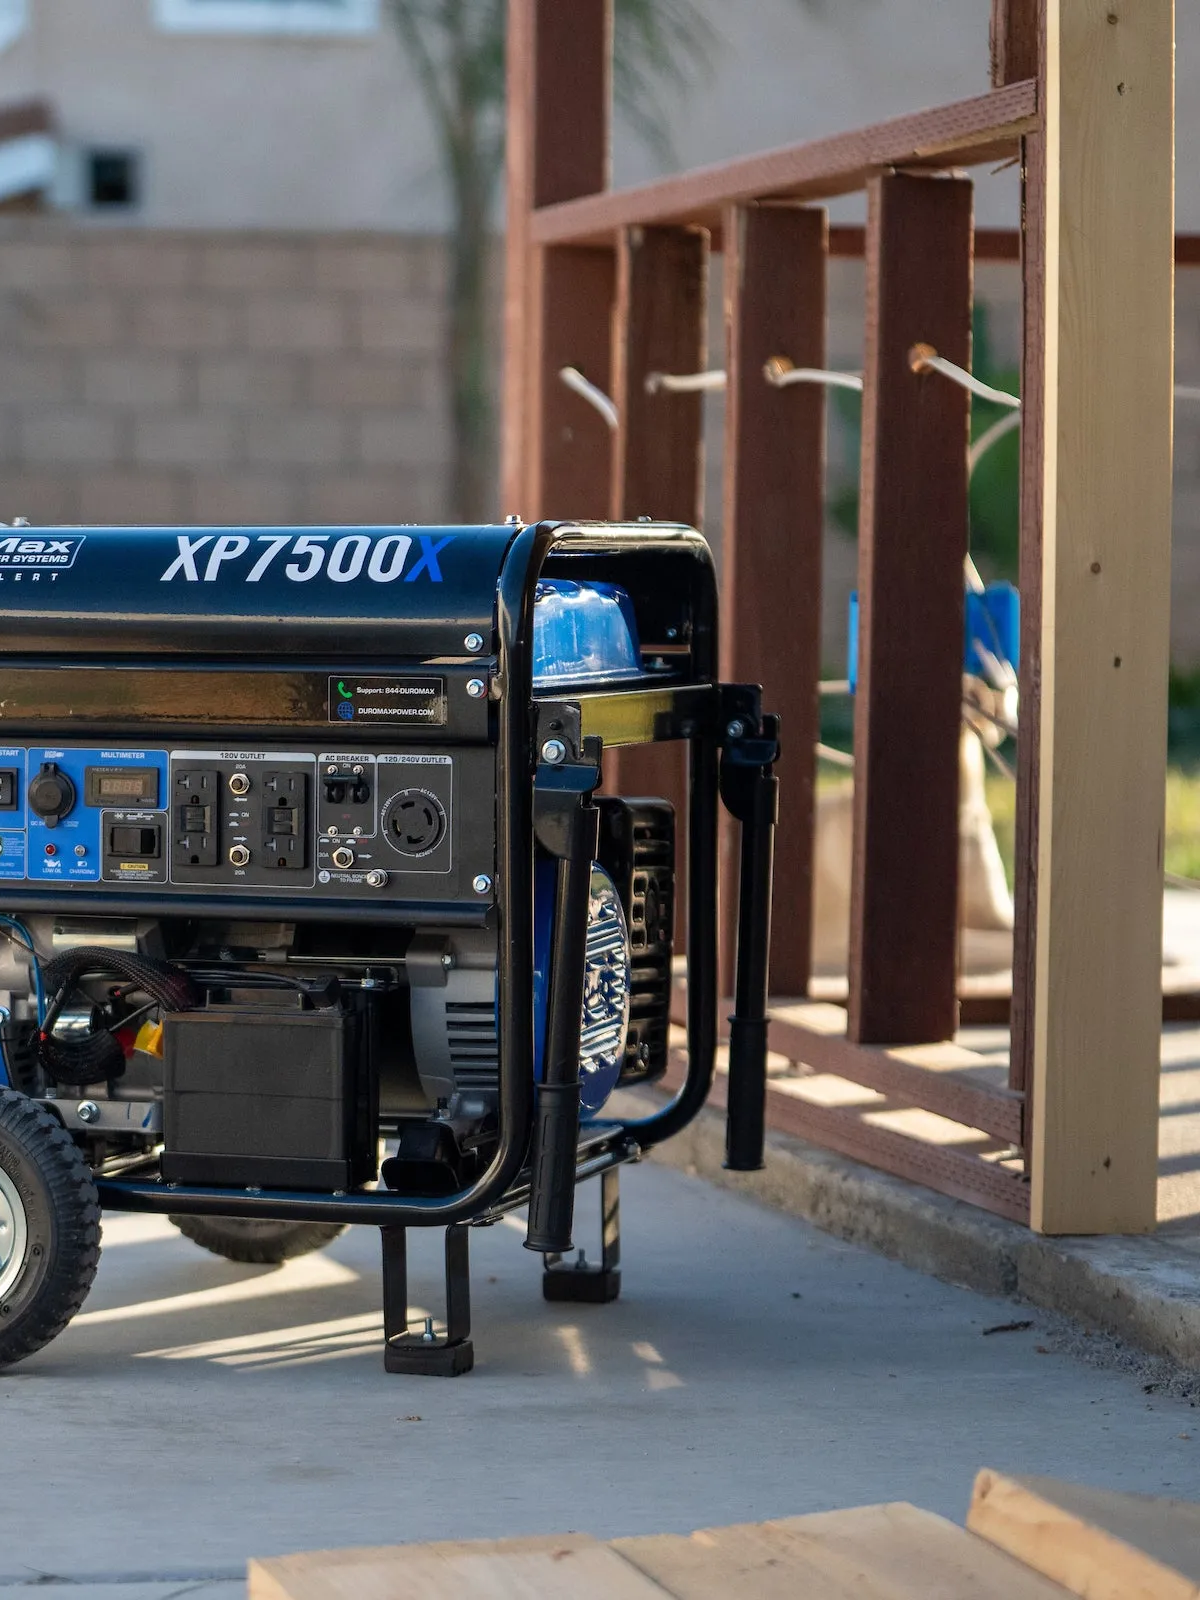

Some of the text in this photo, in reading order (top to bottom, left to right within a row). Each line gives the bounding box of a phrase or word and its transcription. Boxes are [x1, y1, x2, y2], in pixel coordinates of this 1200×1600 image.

[12, 555, 68, 563] SYSTEMS
[160, 535, 457, 583] XP7500X
[356, 686, 435, 695] Support: 844-DUROMAX
[358, 708, 434, 716] DUROMAXPOWER.COM
